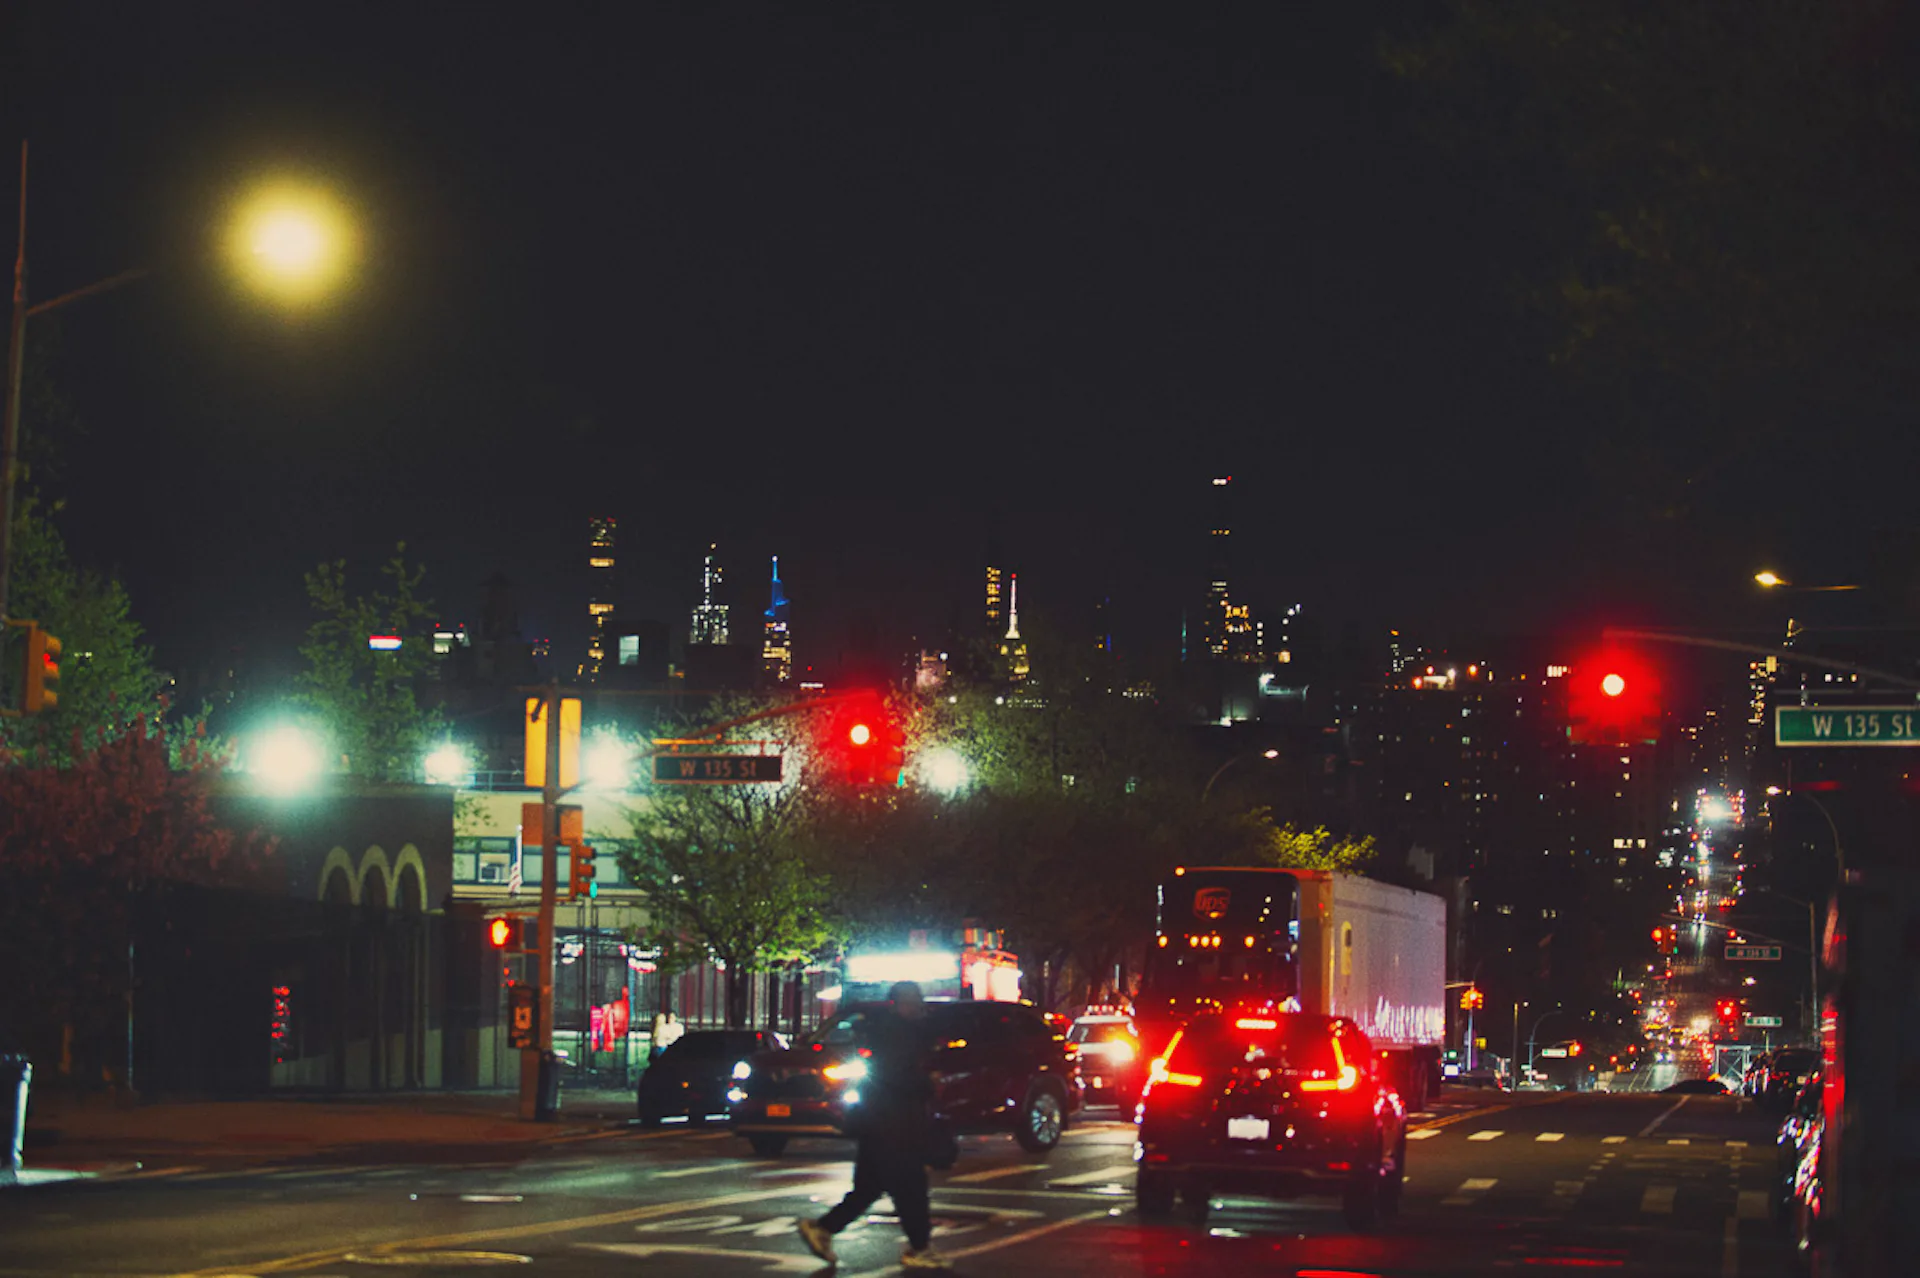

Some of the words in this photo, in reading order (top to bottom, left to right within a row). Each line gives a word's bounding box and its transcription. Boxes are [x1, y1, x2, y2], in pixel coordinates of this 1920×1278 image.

[1812, 714, 1833, 737] W
[1844, 714, 1880, 738] 135
[1891, 714, 1912, 738] St
[680, 760, 695, 777] W
[704, 761, 732, 778] 135
[740, 760, 758, 778] St
